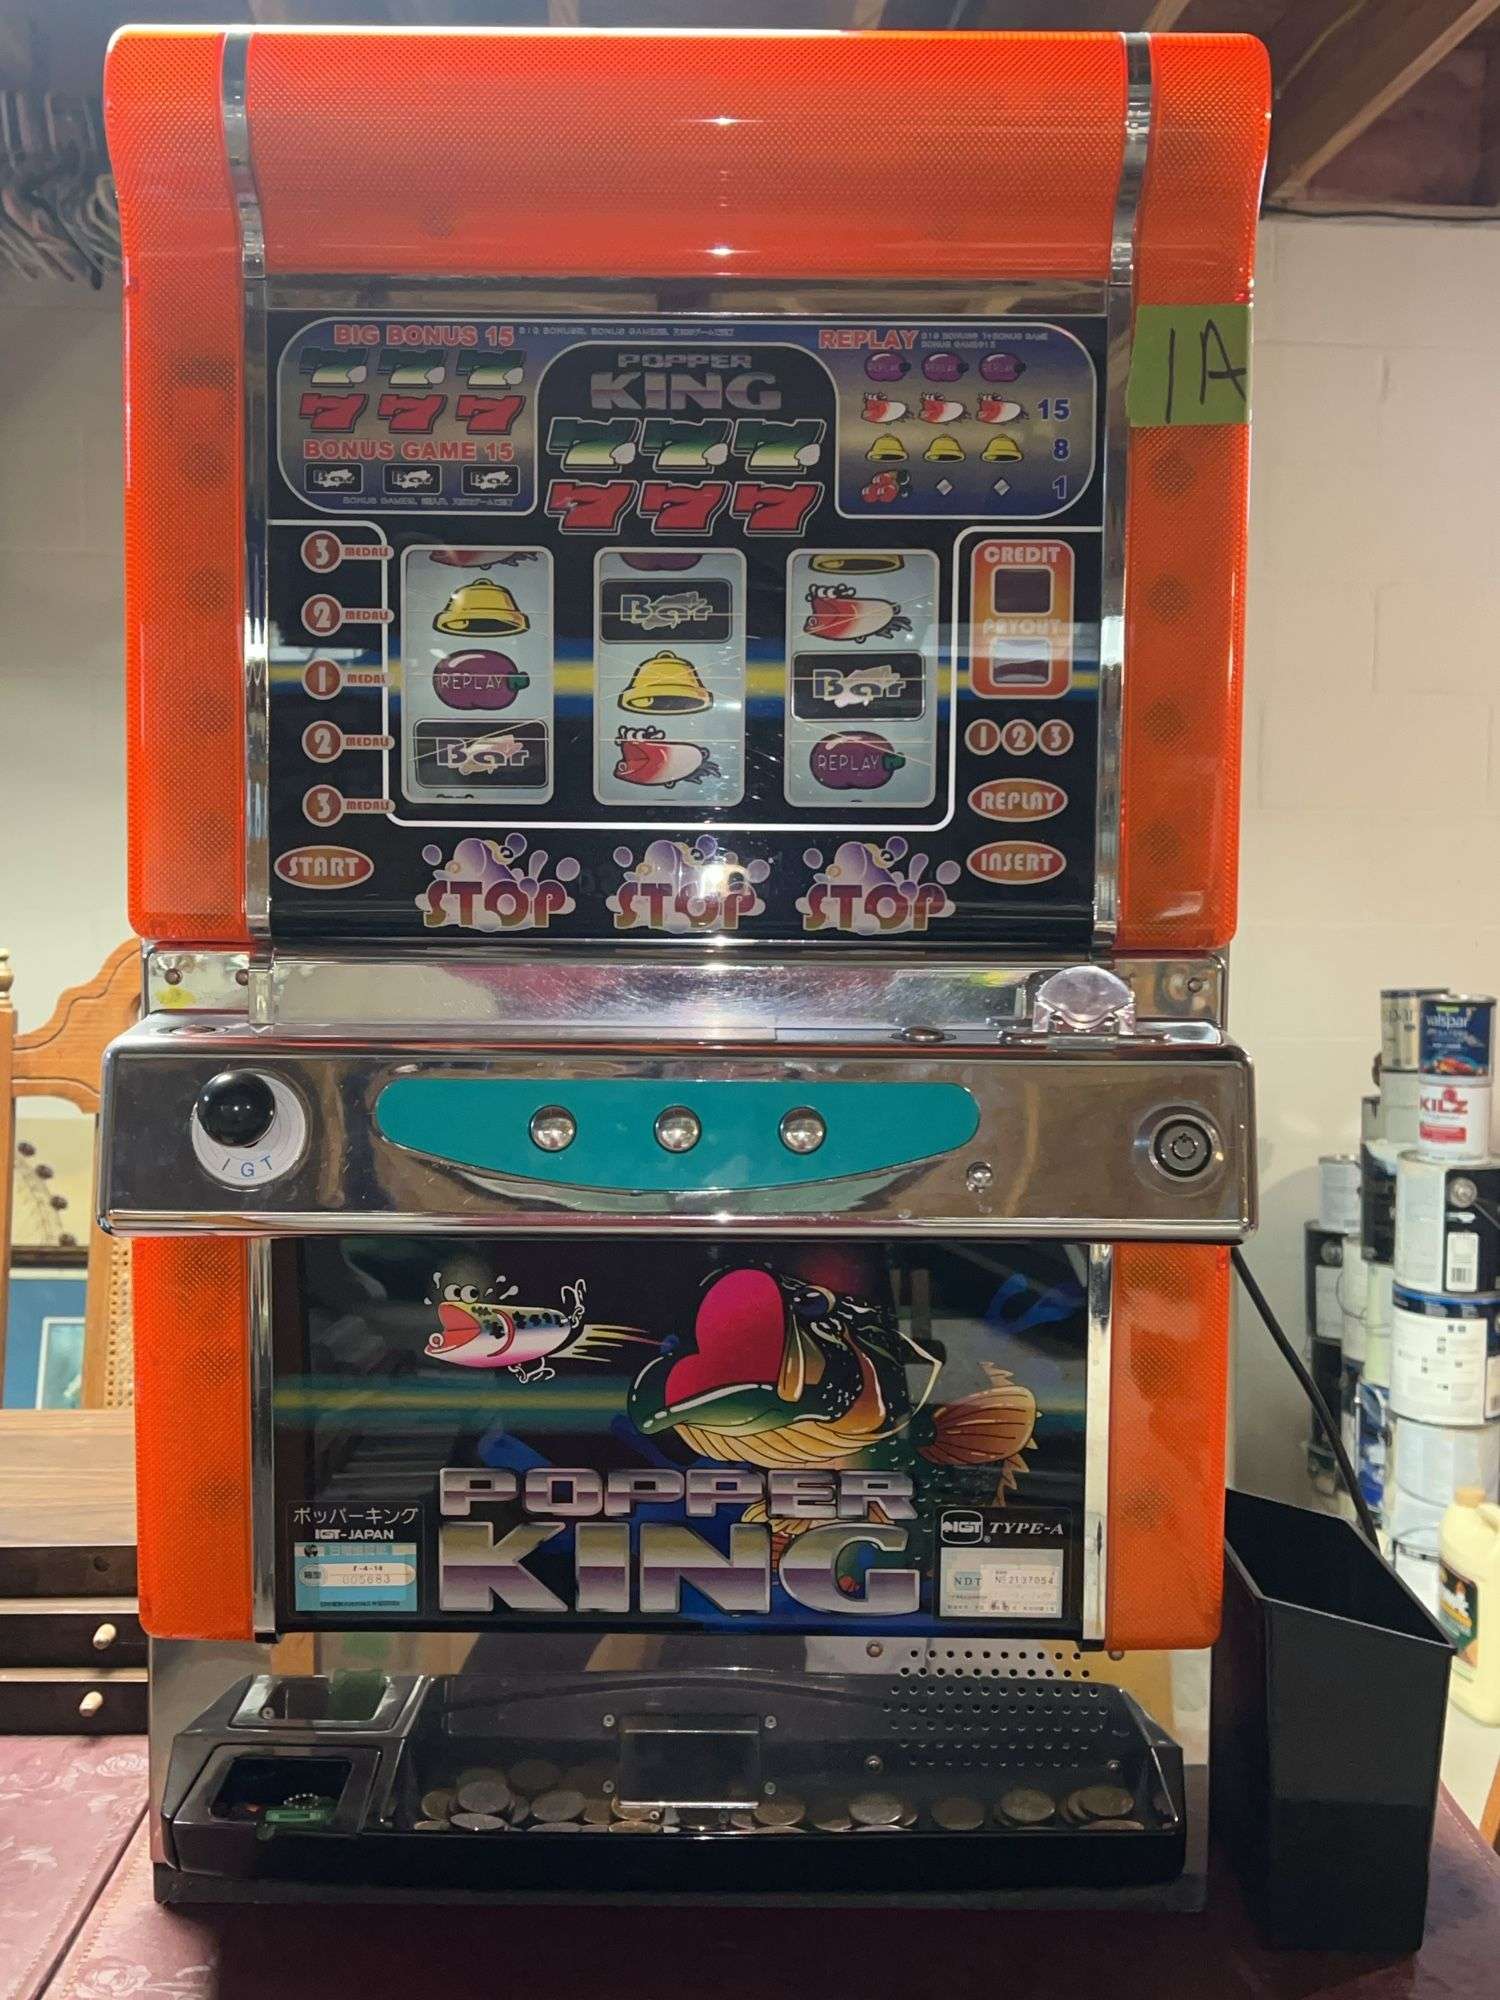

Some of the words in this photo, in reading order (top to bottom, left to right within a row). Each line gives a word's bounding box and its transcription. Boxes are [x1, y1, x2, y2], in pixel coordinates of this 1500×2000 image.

[334, 325, 379, 345] BIG
[386, 326, 477, 346] BONUS
[485, 327, 515, 346] 15
[819, 330, 920, 349] REPLAY
[618, 353, 752, 369] POPPER
[590, 371, 782, 411] KING
[300, 393, 369, 432] 7
[377, 393, 447, 433] 7
[455, 394, 526, 435] 7
[1038, 399, 1070, 421] 15
[304, 438, 395, 460] BONUS
[401, 440, 477, 461] GAME
[485, 441, 514, 461] 15
[1053, 438, 1070, 461] 8
[1052, 475, 1068, 499] 1
[544, 479, 639, 535] 7
[636, 480, 732, 536] 7
[729, 481, 825, 537] 7
[315, 539, 330, 566] 3
[984, 546, 1061, 563] CREDIT
[314, 602, 332, 628] 2
[318, 666, 327, 692] 1
[440, 673, 502, 691] REPLAY
[314, 729, 332, 754] 2
[979, 726, 987, 748] 1
[1013, 725, 1027, 748] 2
[1049, 726, 1062, 749] 3
[816, 754, 880, 771] REPLAY
[316, 792, 331, 819] 3
[980, 791, 1057, 810] REPLAY
[288, 857, 359, 877] START
[980, 853, 1053, 872] INSERT
[423, 878, 568, 929] STOP
[613, 880, 758, 930] STOP
[802, 882, 948, 931] STOP
[1420, 1095, 1469, 1114] KILZ
[222, 1155, 273, 1178] IGT
[440, 1467, 919, 1521] POPPER
[315, 1528, 395, 1540] IGT-JAPAN
[989, 1522, 1064, 1536] TYPE-A
[438, 1520, 922, 1616] KING
[953, 1576, 983, 1587] NDT
